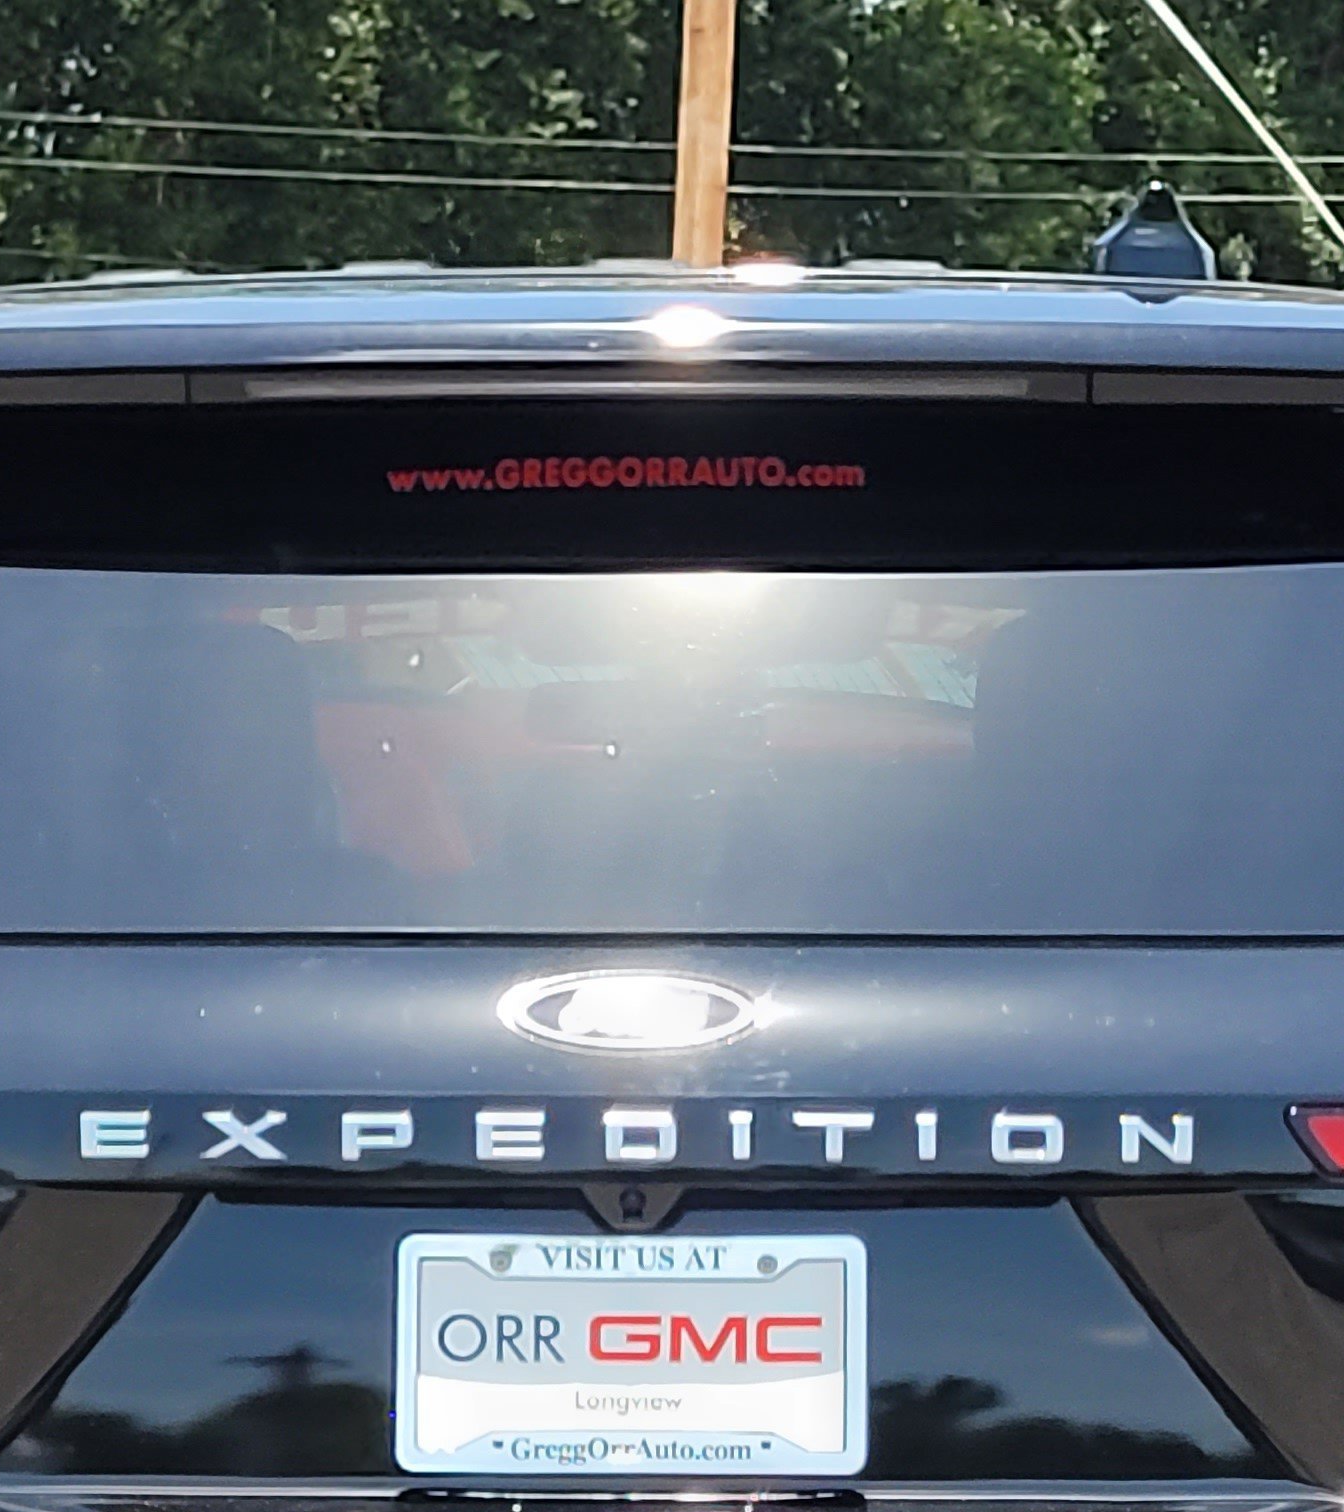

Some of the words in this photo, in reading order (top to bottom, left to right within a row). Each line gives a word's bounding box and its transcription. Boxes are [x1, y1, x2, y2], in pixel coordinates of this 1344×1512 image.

[386, 456, 866, 492] www.GREGGORRAUTO.com
[79, 1108, 1194, 1164] EXPEDITION
[541, 1245, 626, 1272] VISIT
[635, 1246, 675, 1272] US
[684, 1246, 728, 1271] AT
[437, 1313, 564, 1364] ORR
[588, 1315, 823, 1364] GMC
[575, 1390, 683, 1416] Longview
[510, 1436, 752, 1467] GreggOrrAuto.com
